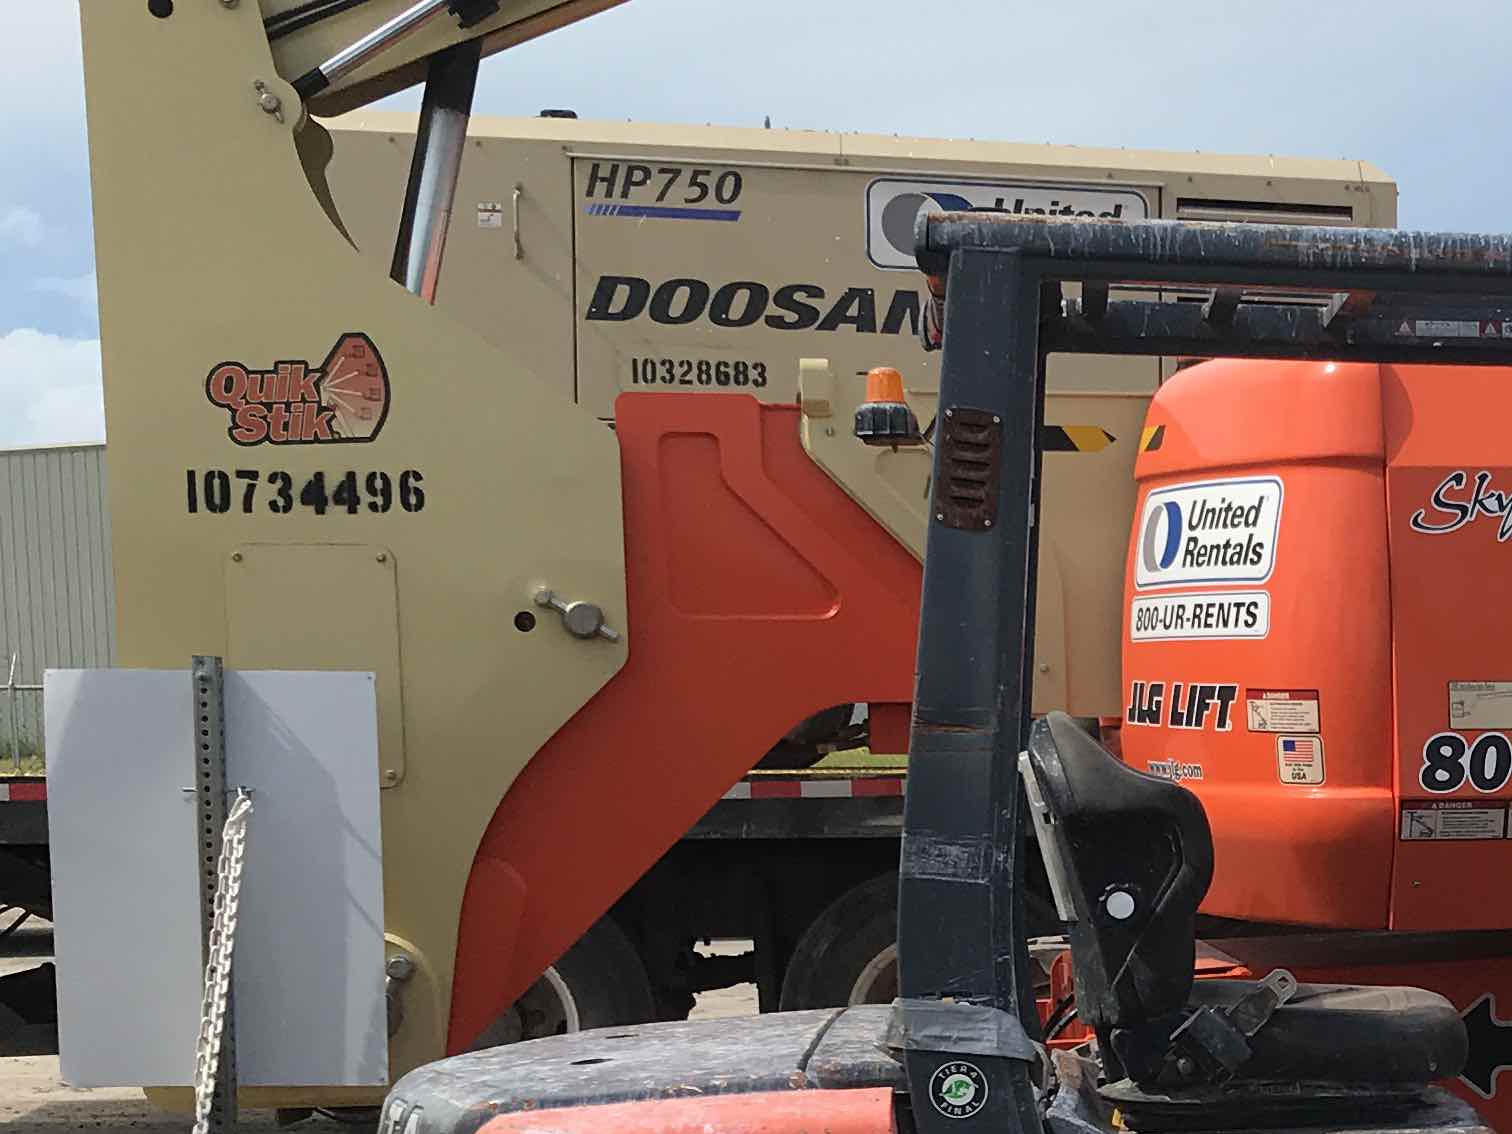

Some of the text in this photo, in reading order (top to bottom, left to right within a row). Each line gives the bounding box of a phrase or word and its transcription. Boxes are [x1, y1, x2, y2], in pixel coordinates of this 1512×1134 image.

[586, 162, 743, 205] HP750
[208, 361, 321, 409] Quik
[632, 356, 768, 388] 10328683
[232, 402, 334, 445] Stik
[187, 469, 425, 516] 10734496
[1187, 495, 1263, 531] United
[1182, 533, 1264, 569] Rentals
[1135, 601, 1259, 632] 800-UR-RENTS
[1127, 681, 1165, 726] JLG
[1168, 682, 1238, 730] LIFT
